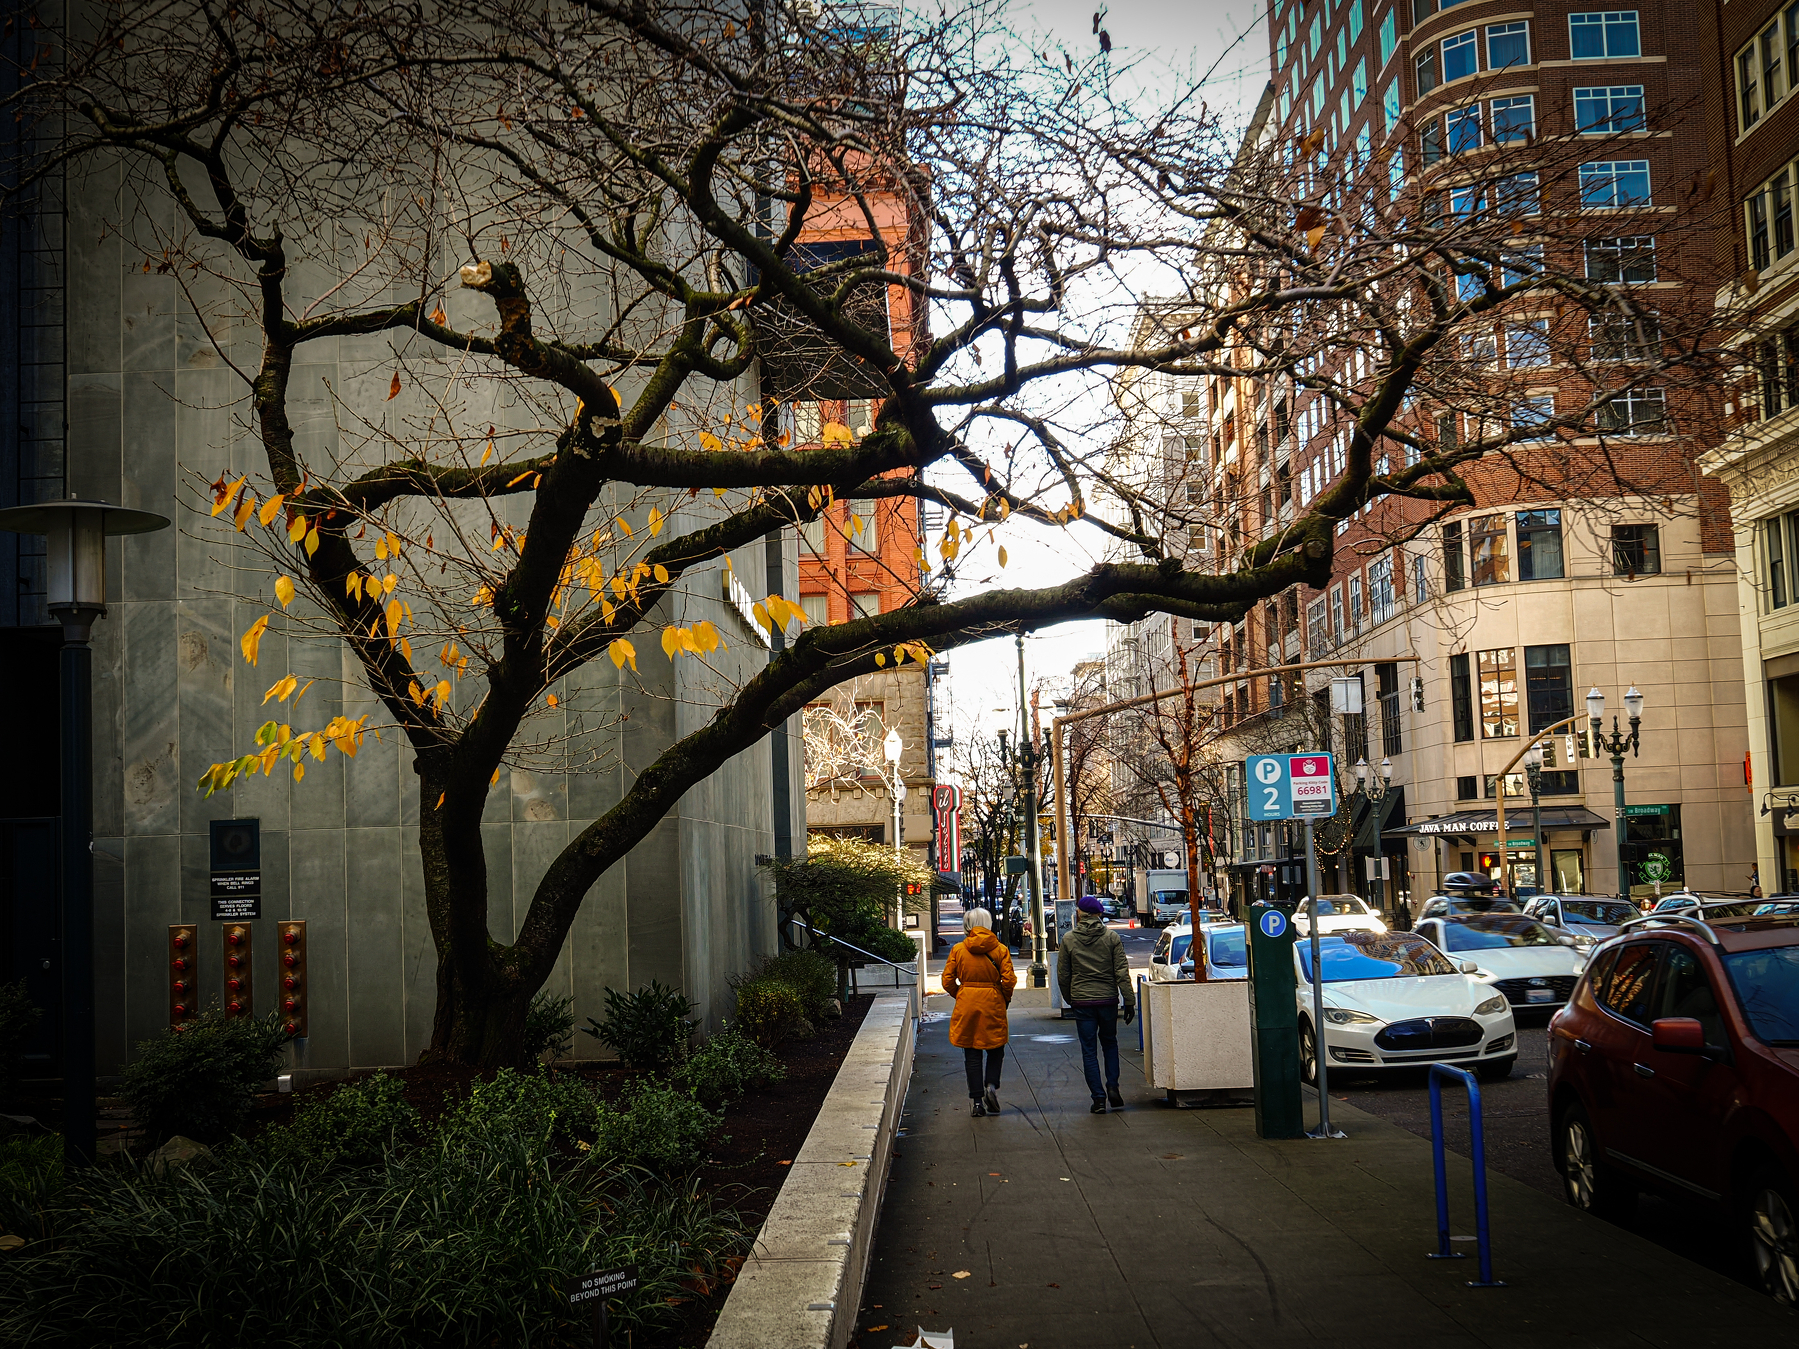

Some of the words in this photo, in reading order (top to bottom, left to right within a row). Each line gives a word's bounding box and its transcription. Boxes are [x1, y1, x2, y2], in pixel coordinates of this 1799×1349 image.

[1263, 762, 1276, 780] P
[1263, 787, 1280, 810] 2
[1297, 786, 1327, 795] 66981
[1634, 806, 1660, 815] Broadway
[1419, 824, 1440, 833] JAVA
[1443, 823, 1466, 832] MAN
[1470, 821, 1510, 831] COFFE
[1268, 916, 1280, 934] P
[582, 1280, 593, 1289] NO
[594, 1272, 625, 1286] SMOKING
[570, 1288, 599, 1303] BEYOND
[601, 1284, 616, 1294] THIS
[618, 1279, 637, 1290] POINT
